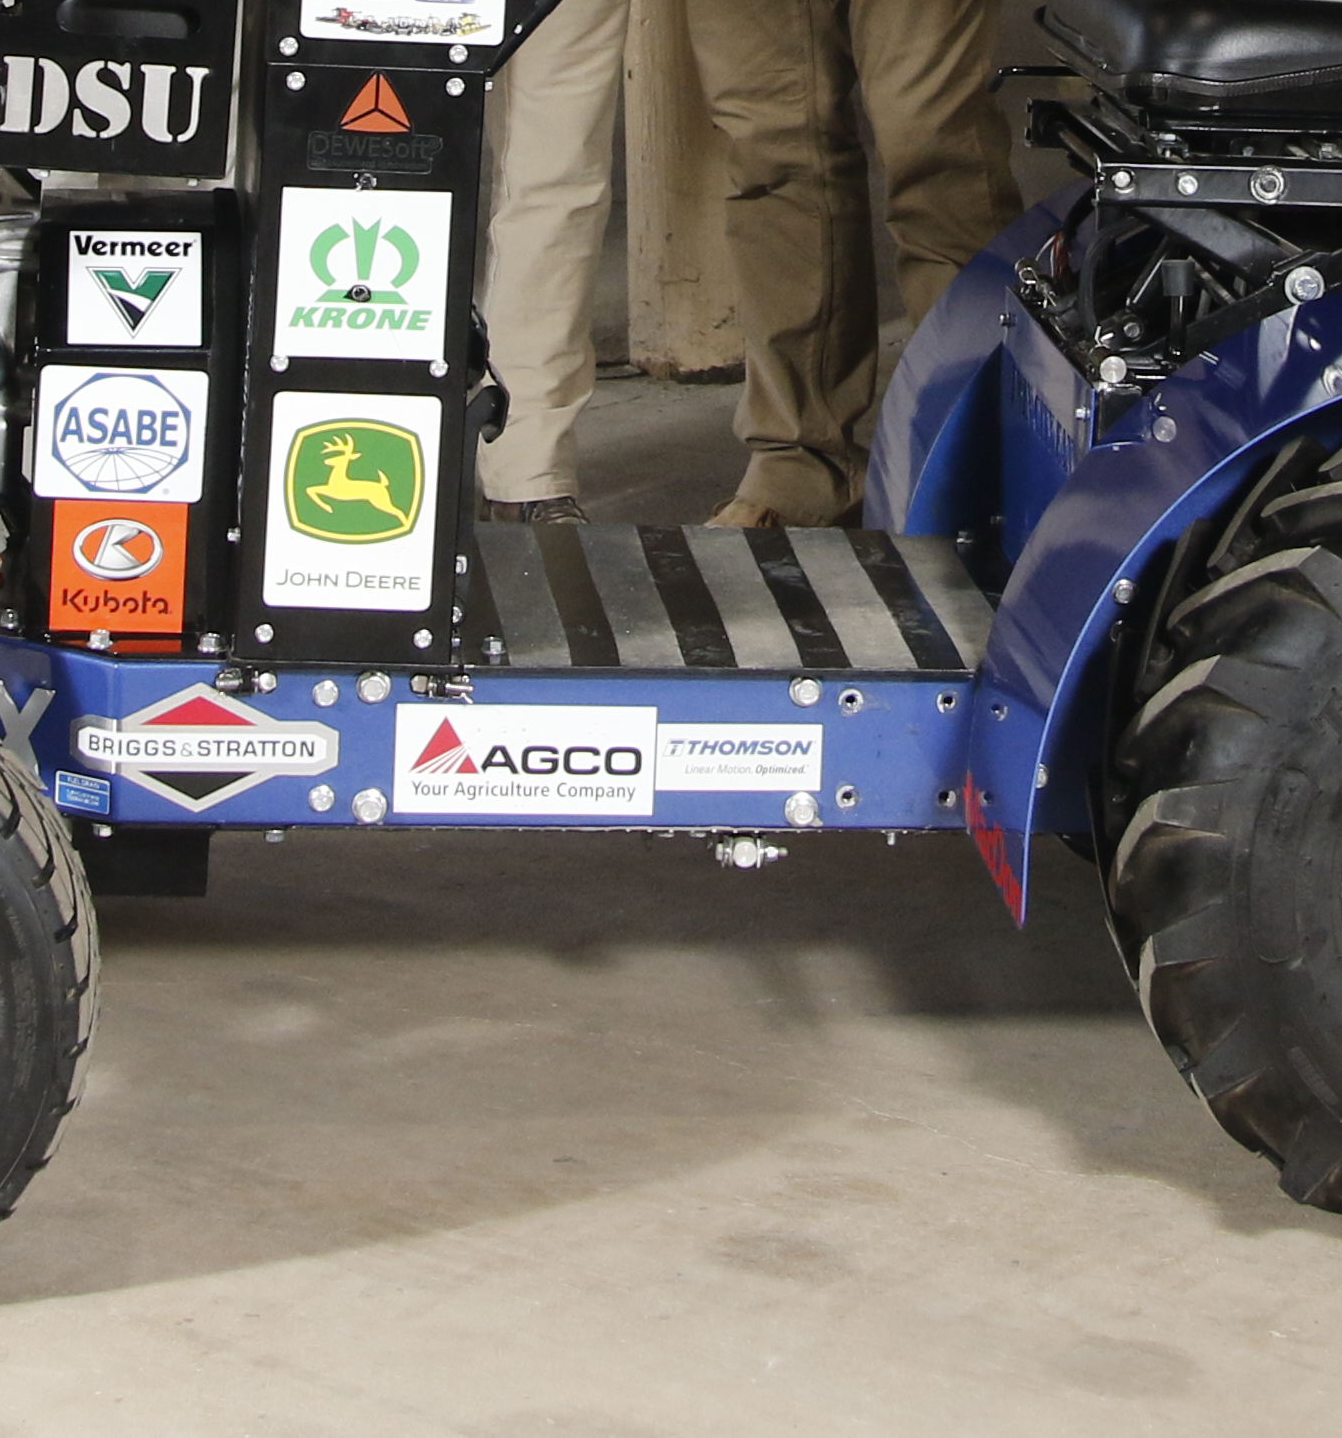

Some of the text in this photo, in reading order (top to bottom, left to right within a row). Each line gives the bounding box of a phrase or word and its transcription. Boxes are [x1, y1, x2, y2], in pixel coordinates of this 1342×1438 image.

[73, 234, 193, 257] Vermeer
[289, 306, 433, 331] KRONE
[59, 406, 180, 447] ASABE
[275, 569, 422, 591] JOHN DEERE
[62, 588, 170, 615] Kubota
[88, 734, 176, 757] BRIGGS
[196, 739, 316, 759] STRATTON
[686, 739, 813, 756] THOMSON
[480, 744, 643, 776] AGCO
[684, 763, 716, 774] Linear
[411, 781, 637, 802] Your Agriculture Company
